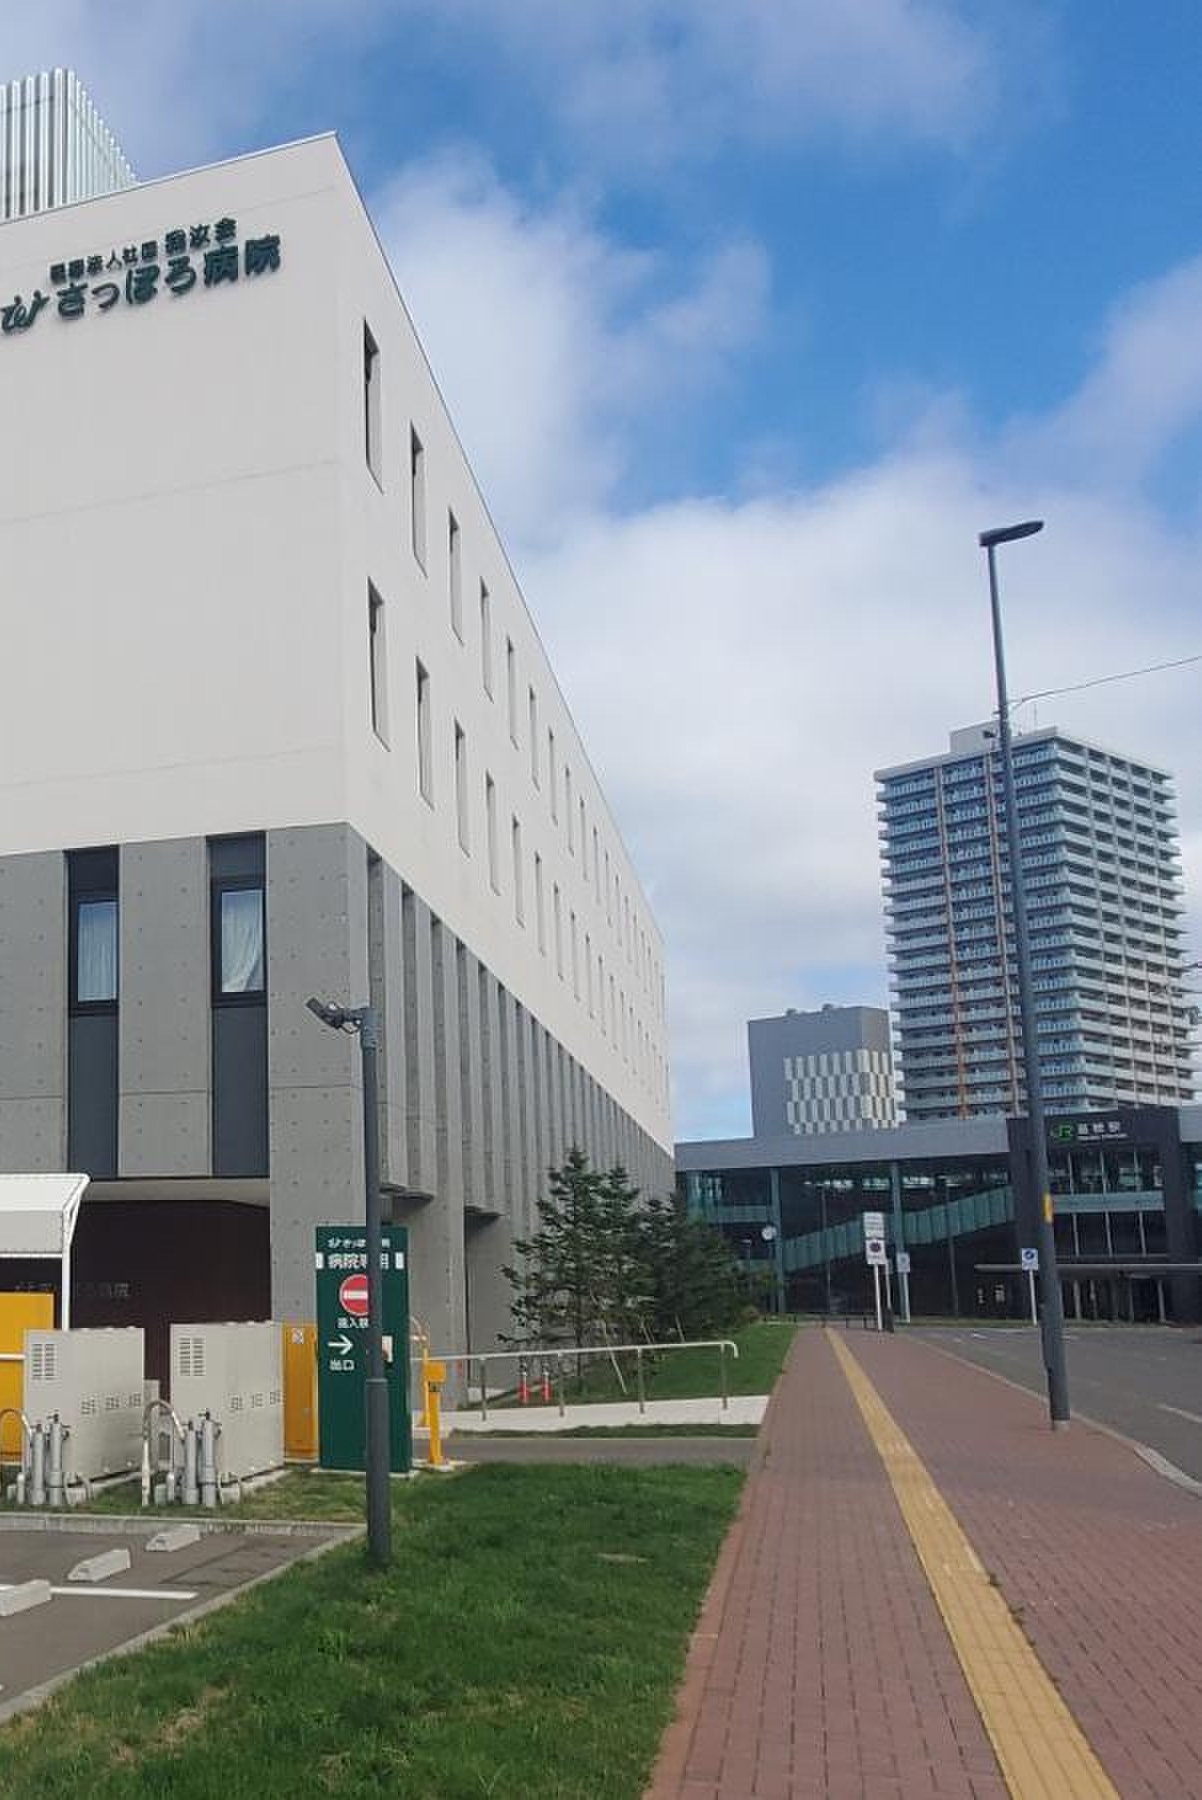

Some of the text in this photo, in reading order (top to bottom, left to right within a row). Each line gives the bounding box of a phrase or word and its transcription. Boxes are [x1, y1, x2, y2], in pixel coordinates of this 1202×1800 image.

[57, 234, 280, 318] さっぽろ病院
[329, 1358, 354, 1371] 出口
